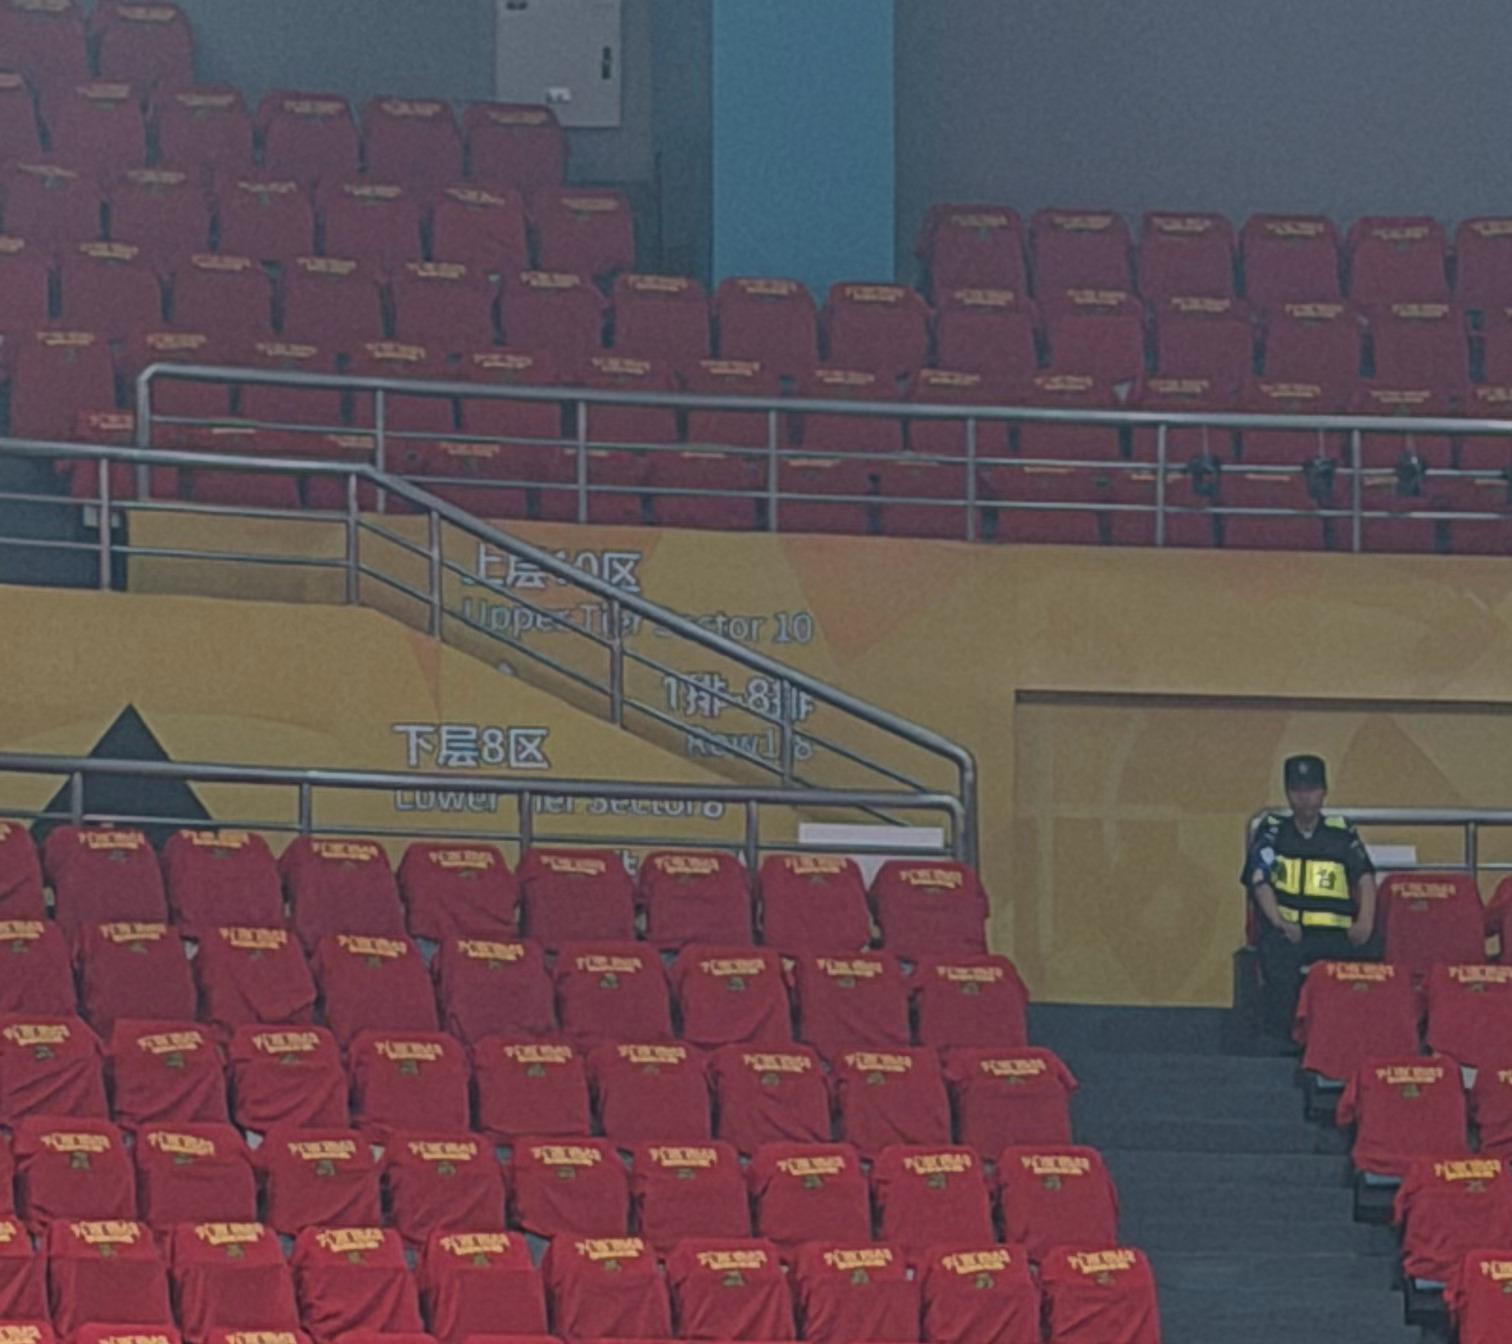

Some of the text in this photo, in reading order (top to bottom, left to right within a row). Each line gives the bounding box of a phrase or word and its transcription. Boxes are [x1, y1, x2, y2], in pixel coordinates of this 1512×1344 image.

[774, 612, 812, 643] 10
[393, 724, 549, 769] 下层8区
